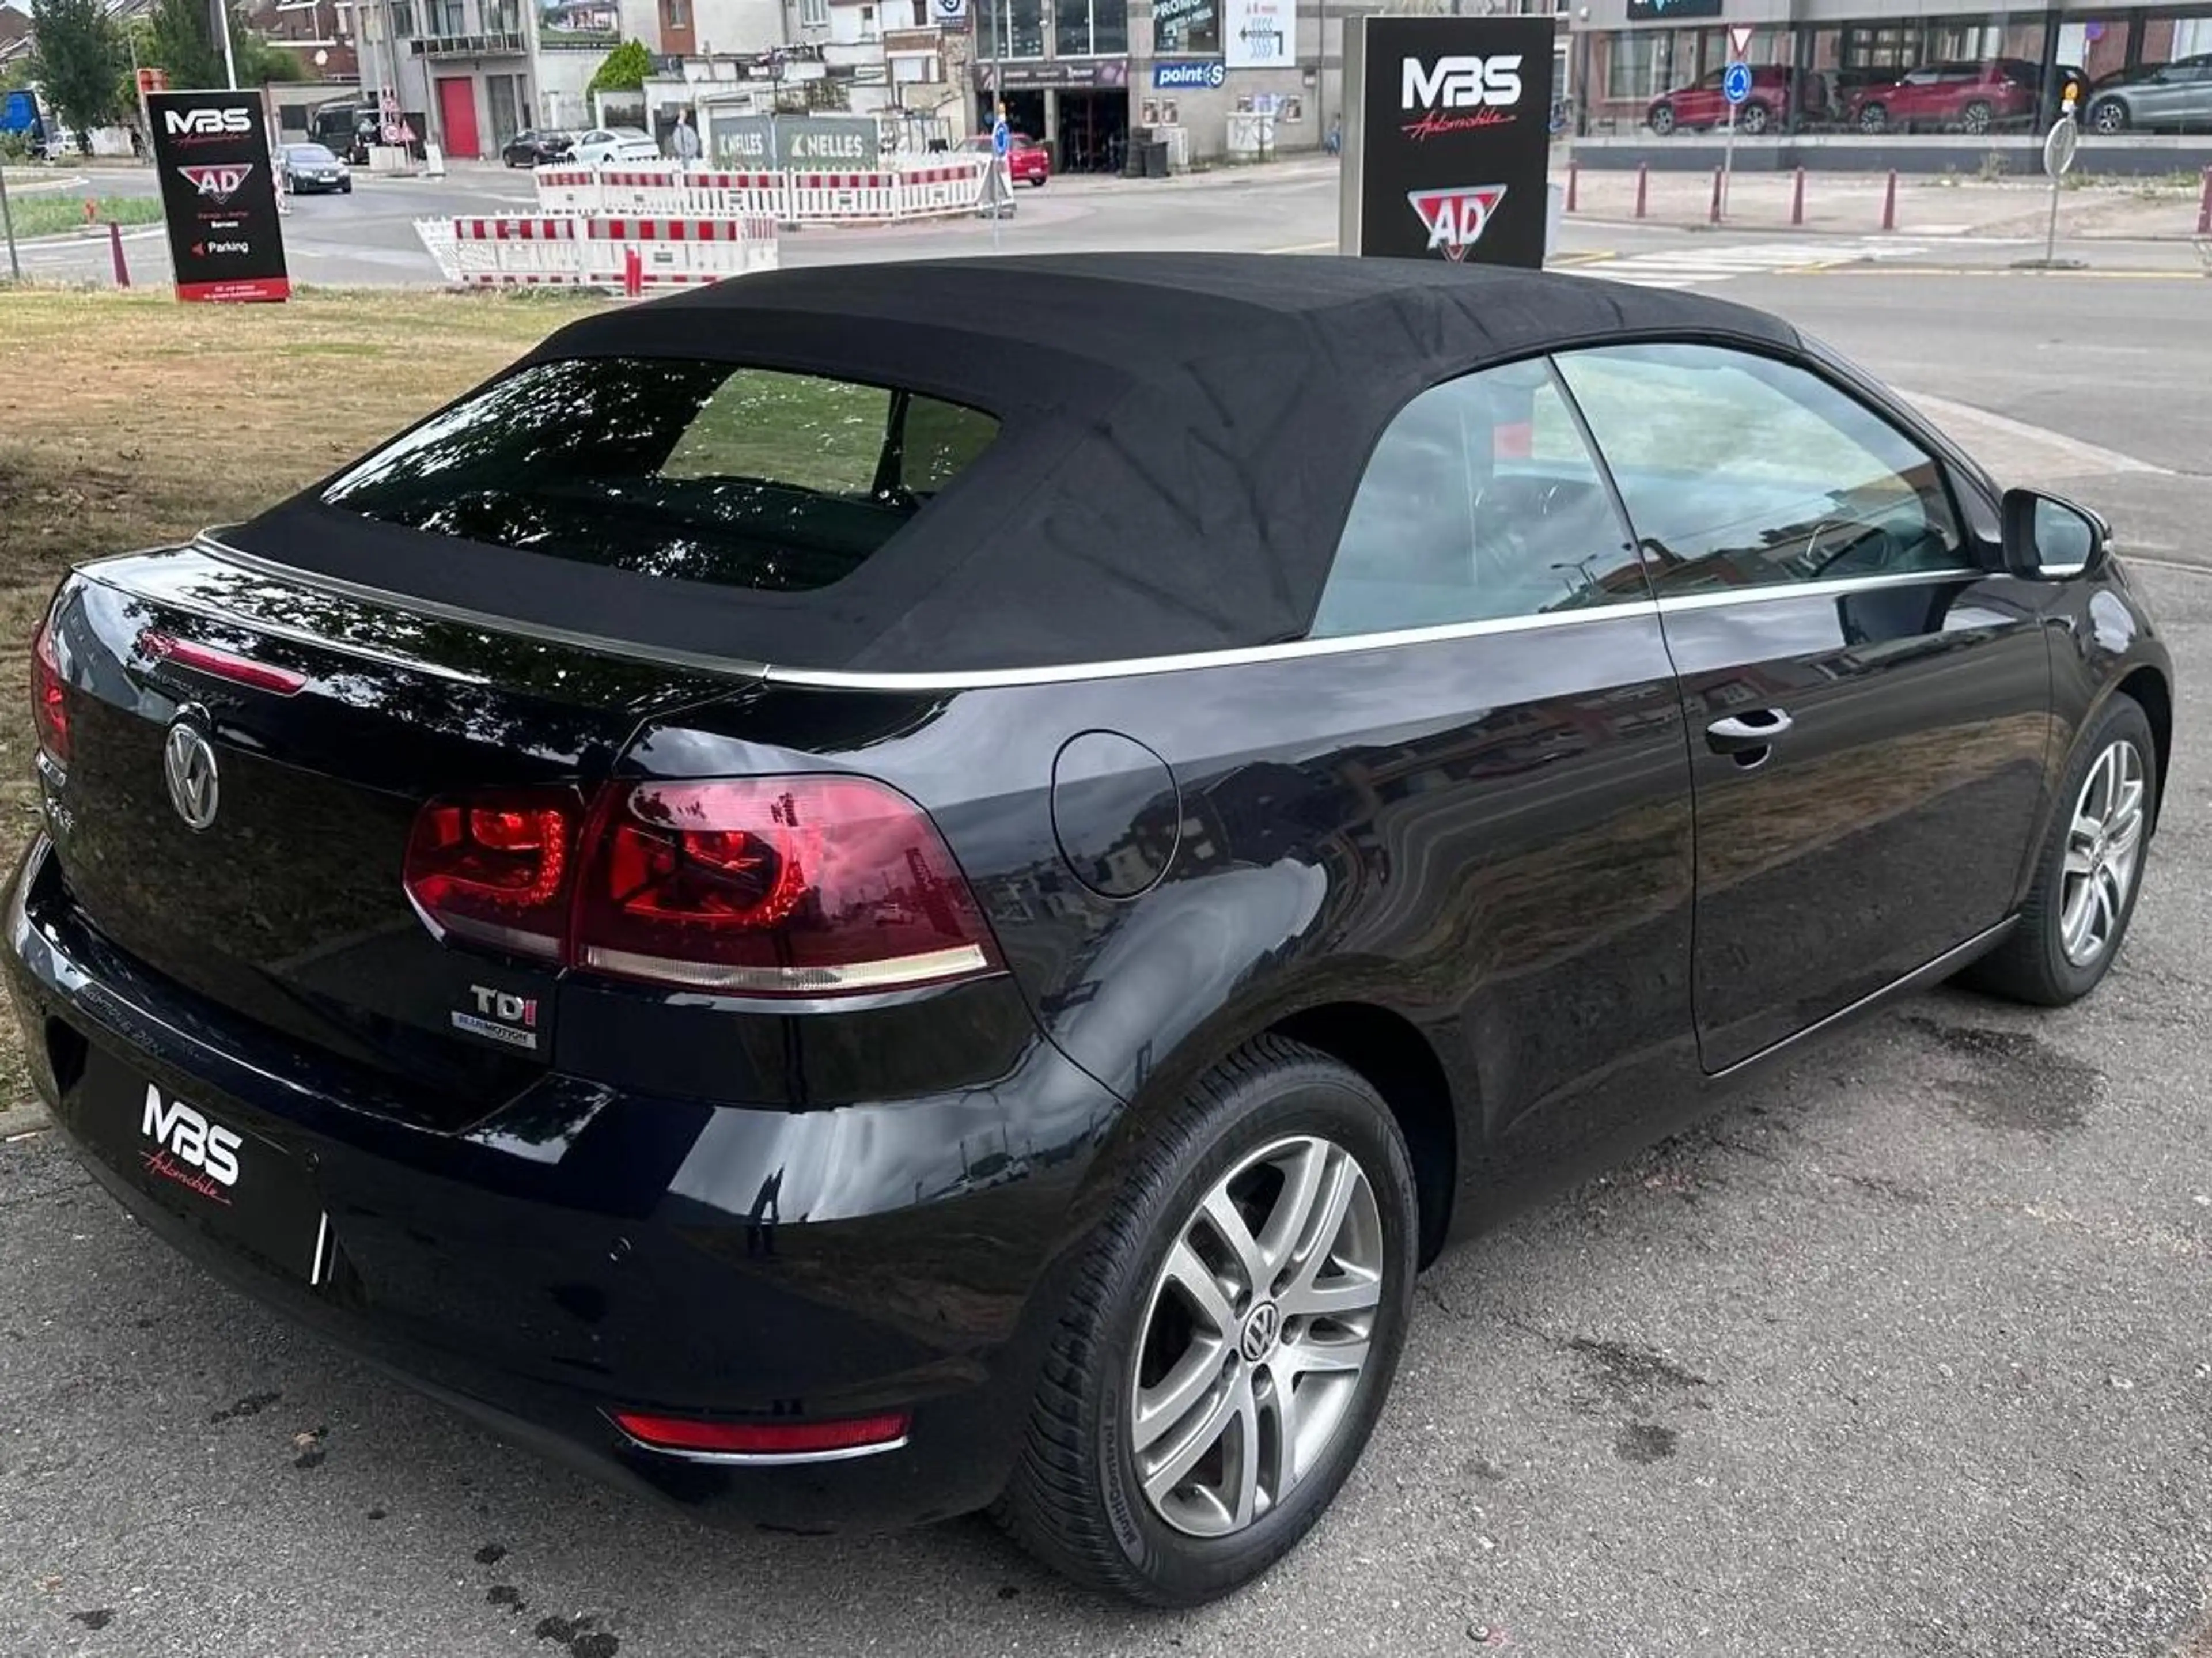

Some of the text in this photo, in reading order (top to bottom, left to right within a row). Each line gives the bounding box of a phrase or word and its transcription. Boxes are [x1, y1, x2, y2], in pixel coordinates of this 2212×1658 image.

[1159, 65, 1224, 85] point S
[1402, 55, 1522, 109] MBS
[164, 108, 252, 134] MBS
[809, 134, 863, 158] NELLES
[198, 171, 240, 195] AD
[1427, 197, 1486, 250] AD
[207, 241, 249, 254] Parking
[469, 983, 538, 1028] TDI
[142, 1082, 243, 1186] MBS
